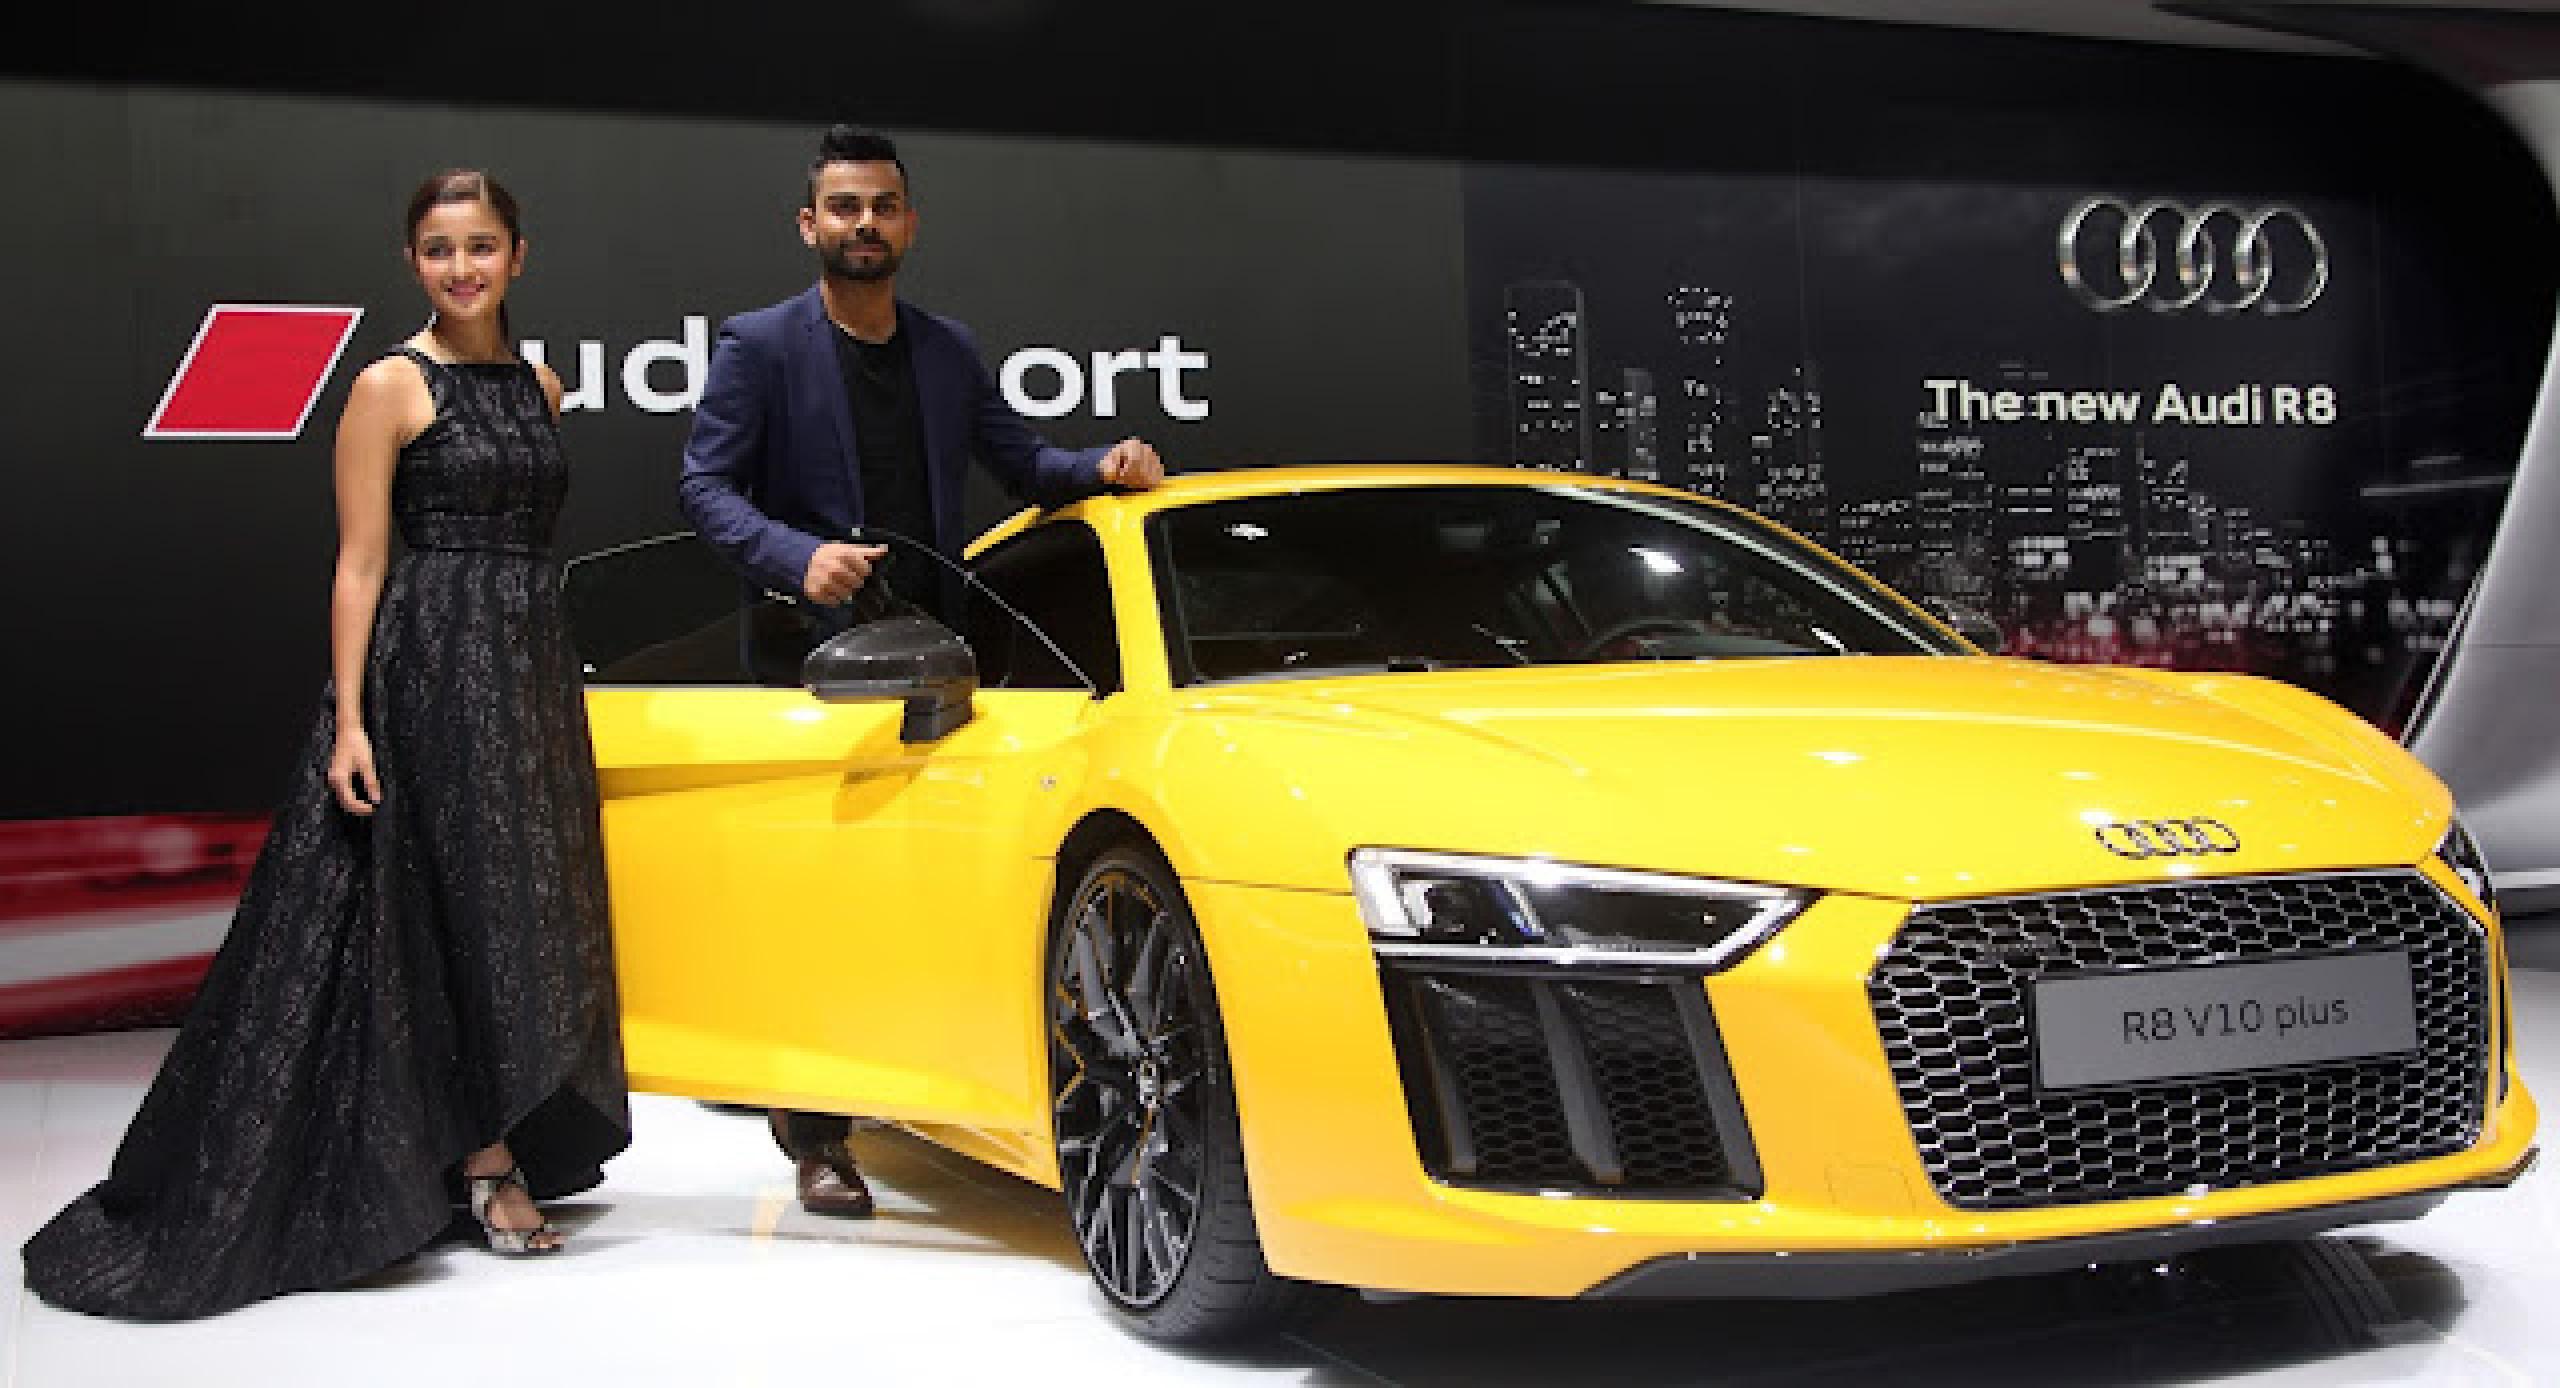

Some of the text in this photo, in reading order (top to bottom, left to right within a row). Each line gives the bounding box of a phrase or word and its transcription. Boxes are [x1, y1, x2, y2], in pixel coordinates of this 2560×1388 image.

[519, 314, 1209, 421] ud ort
[1922, 378, 2338, 425] The new Audi R8
[2123, 995, 2350, 1045] R8 V10 plus
